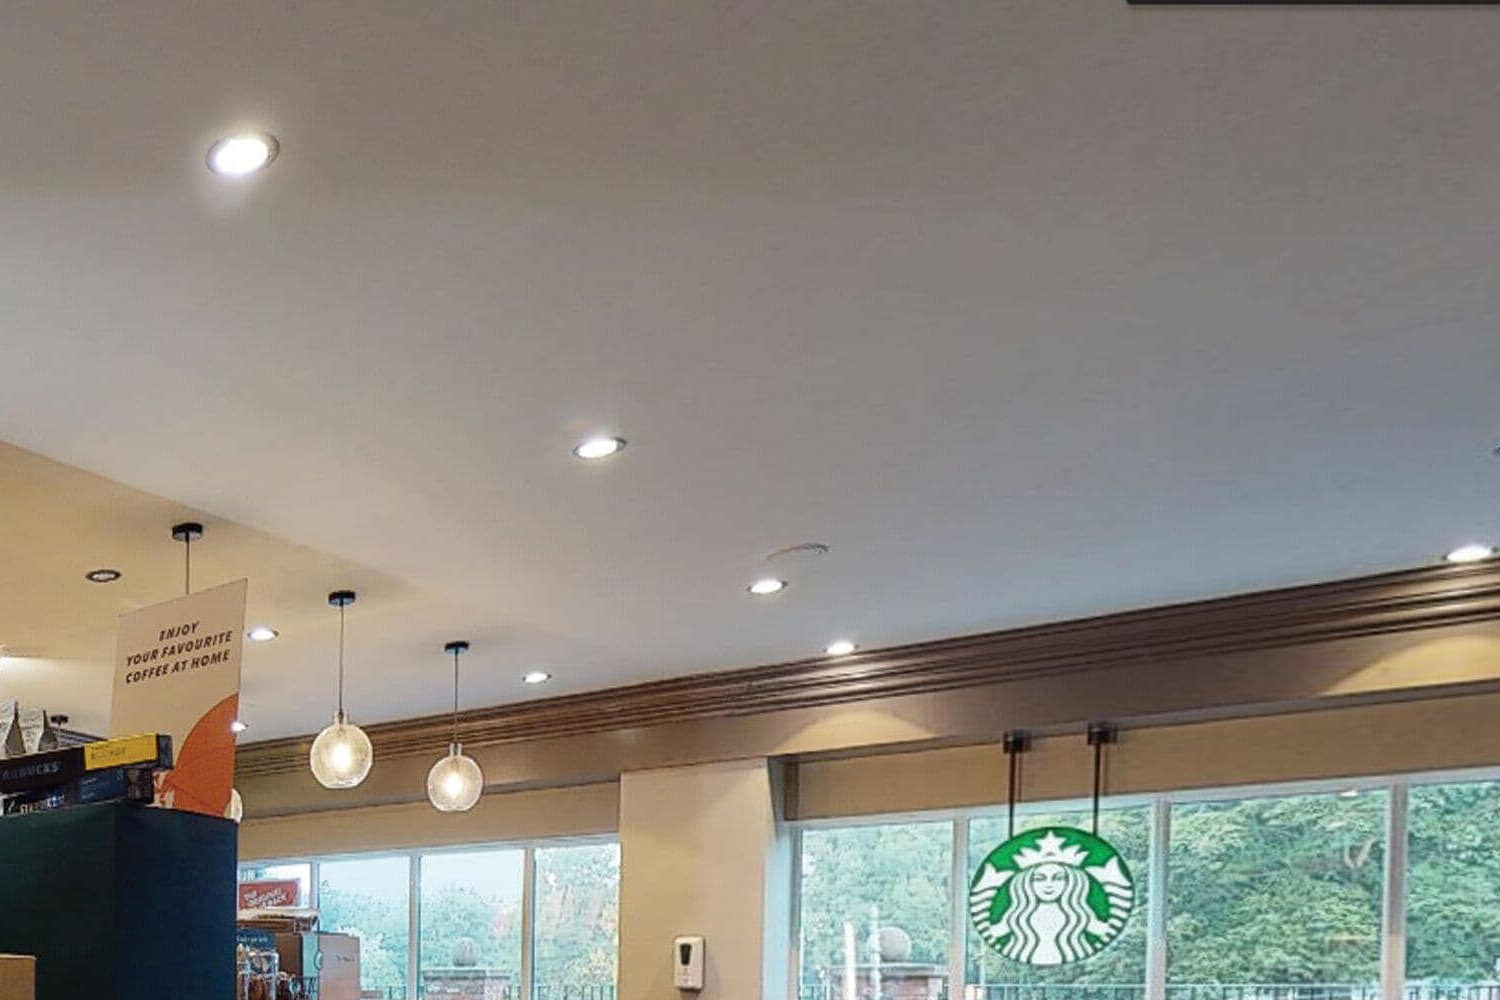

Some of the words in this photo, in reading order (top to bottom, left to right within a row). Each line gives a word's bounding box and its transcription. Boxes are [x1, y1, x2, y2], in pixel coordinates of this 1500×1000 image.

[127, 648, 159, 667] YOUR
[161, 630, 233, 659] FAVOURITE
[159, 621, 200, 642] ENJOY
[125, 663, 170, 684] COFFEE
[171, 659, 189, 673] AT
[189, 649, 230, 669] HOME
